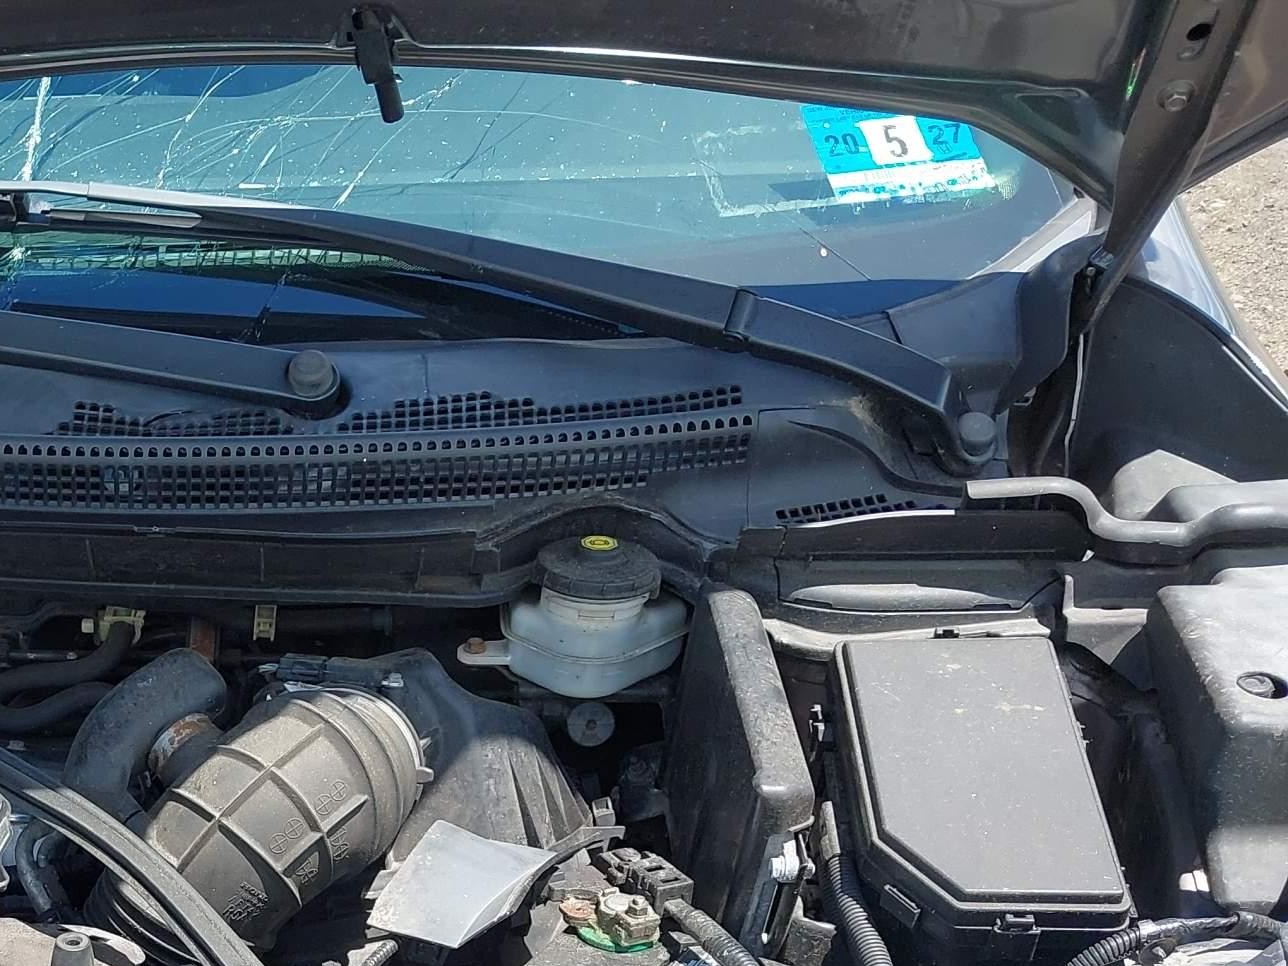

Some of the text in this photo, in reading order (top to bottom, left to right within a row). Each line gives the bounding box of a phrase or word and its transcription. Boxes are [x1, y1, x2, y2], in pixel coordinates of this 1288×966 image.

[824, 122, 962, 158] 20 5 27
